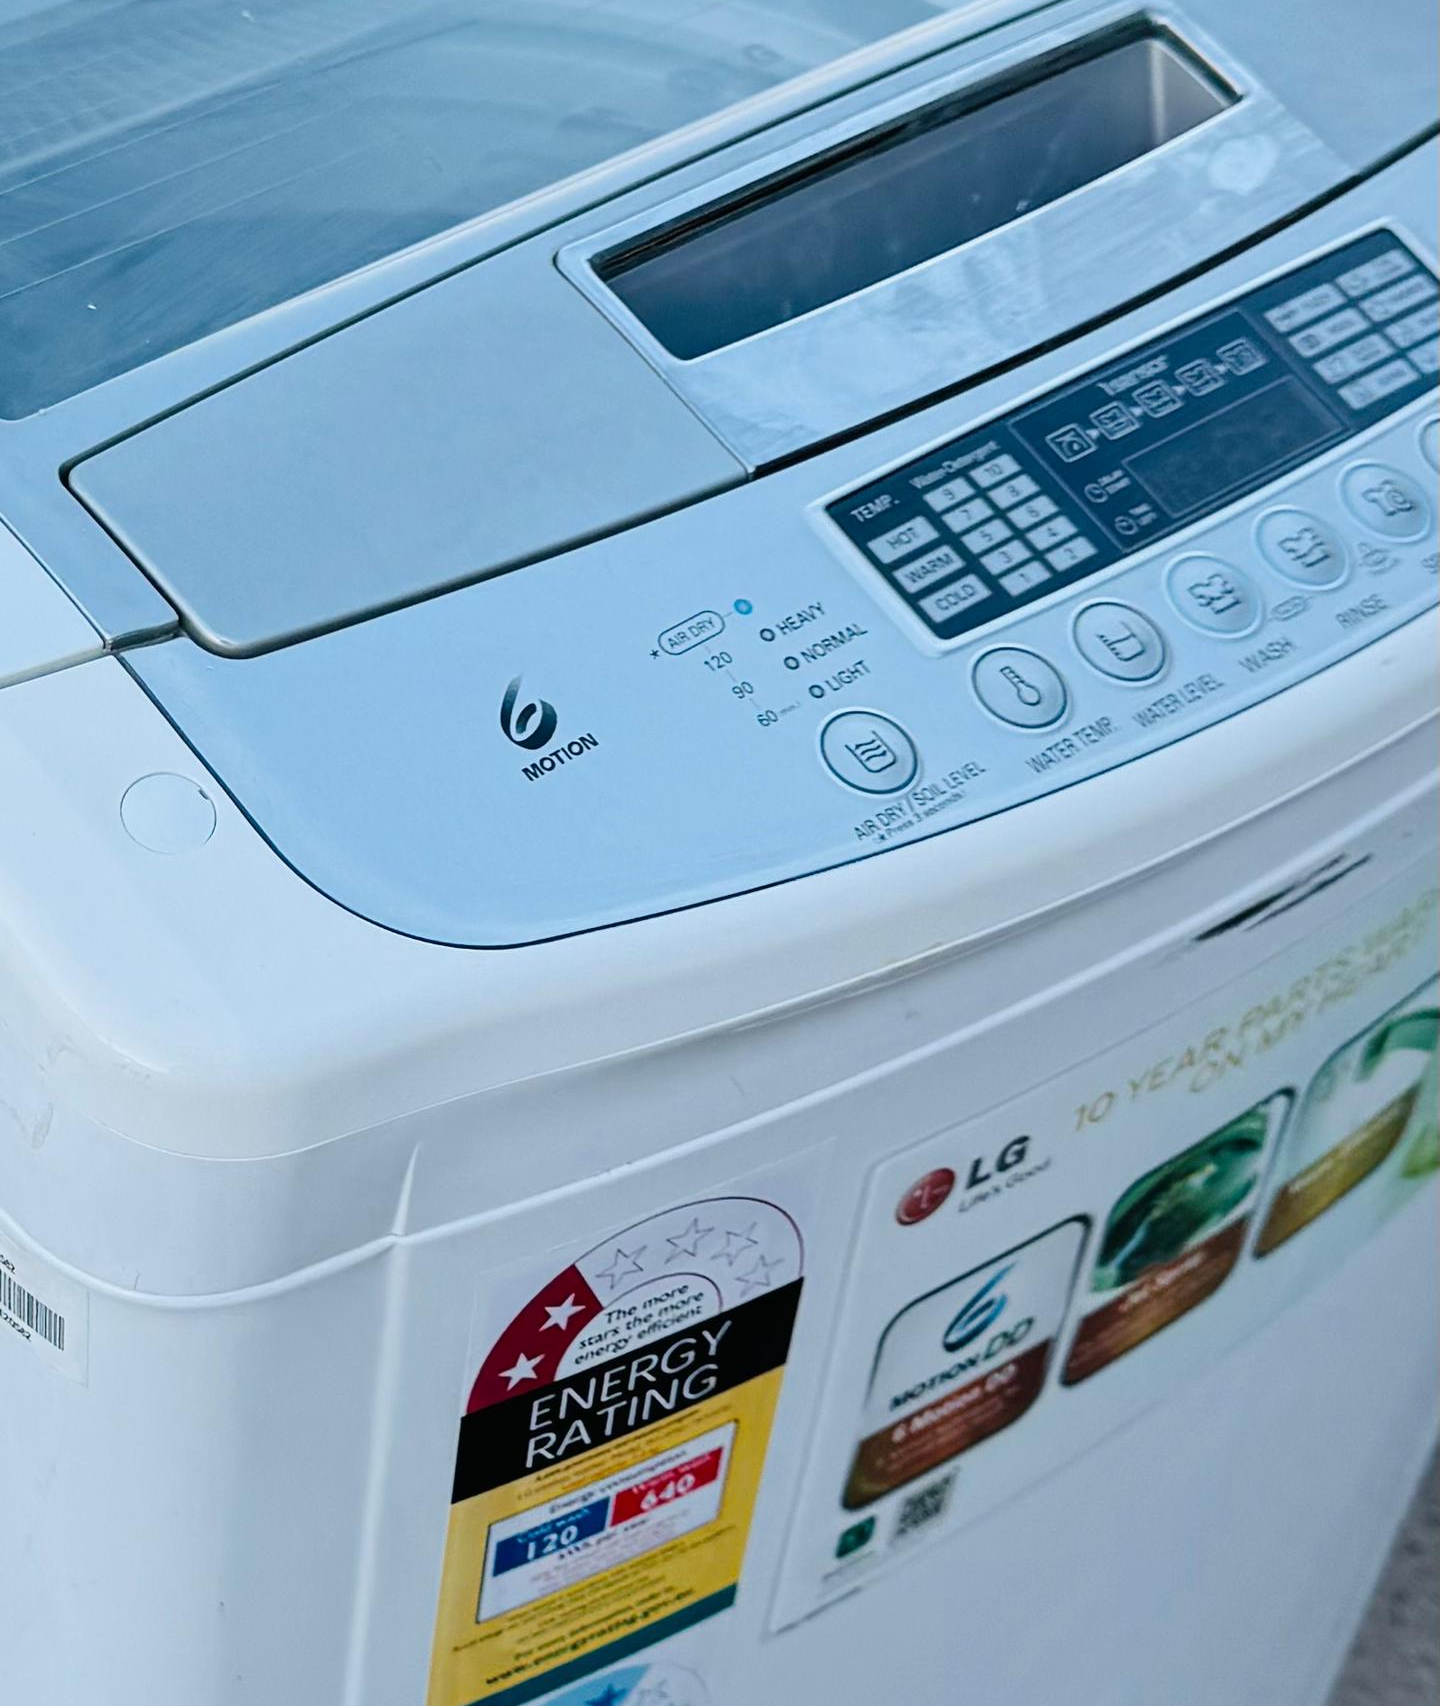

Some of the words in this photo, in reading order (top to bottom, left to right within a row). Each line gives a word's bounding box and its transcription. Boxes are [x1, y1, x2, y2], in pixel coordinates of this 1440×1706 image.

[850, 494, 901, 522] TEMP.
[886, 526, 921, 550] HOT
[904, 552, 954, 584] WARM
[935, 583, 977, 611] COLD
[667, 631, 688, 649] AIR
[687, 617, 716, 639] DRY
[775, 601, 827, 636] HEAVY
[800, 622, 870, 664] NORMAL
[1237, 636, 1298, 673] WASH
[704, 651, 733, 673] 120
[824, 659, 872, 692] LIGHT
[732, 681, 754, 699] 90
[1131, 693, 1184, 727] WATER
[1176, 672, 1226, 704] LEVEL
[757, 709, 779, 727] 60
[521, 732, 600, 782] MOTION
[1025, 737, 1078, 774] WATER
[853, 819, 880, 841] AIR
[876, 801, 908, 828] DRY
[912, 783, 948, 806] SOIL
[941, 761, 988, 791] LEVEL
[1074, 1091, 1114, 1132] 10
[1128, 1027, 1228, 1102] YEAR
[965, 1135, 1032, 1191] LG
[578, 1325, 621, 1350] stars
[625, 1312, 654, 1331] the
[659, 1291, 705, 1317] more
[605, 1305, 638, 1325] The
[642, 1284, 689, 1310] more
[574, 1334, 633, 1366] energy
[636, 1305, 704, 1341] efficient
[529, 1320, 733, 1431] ENERGY
[525, 1363, 720, 1469] RATING
[526, 1524, 580, 1561] 120
